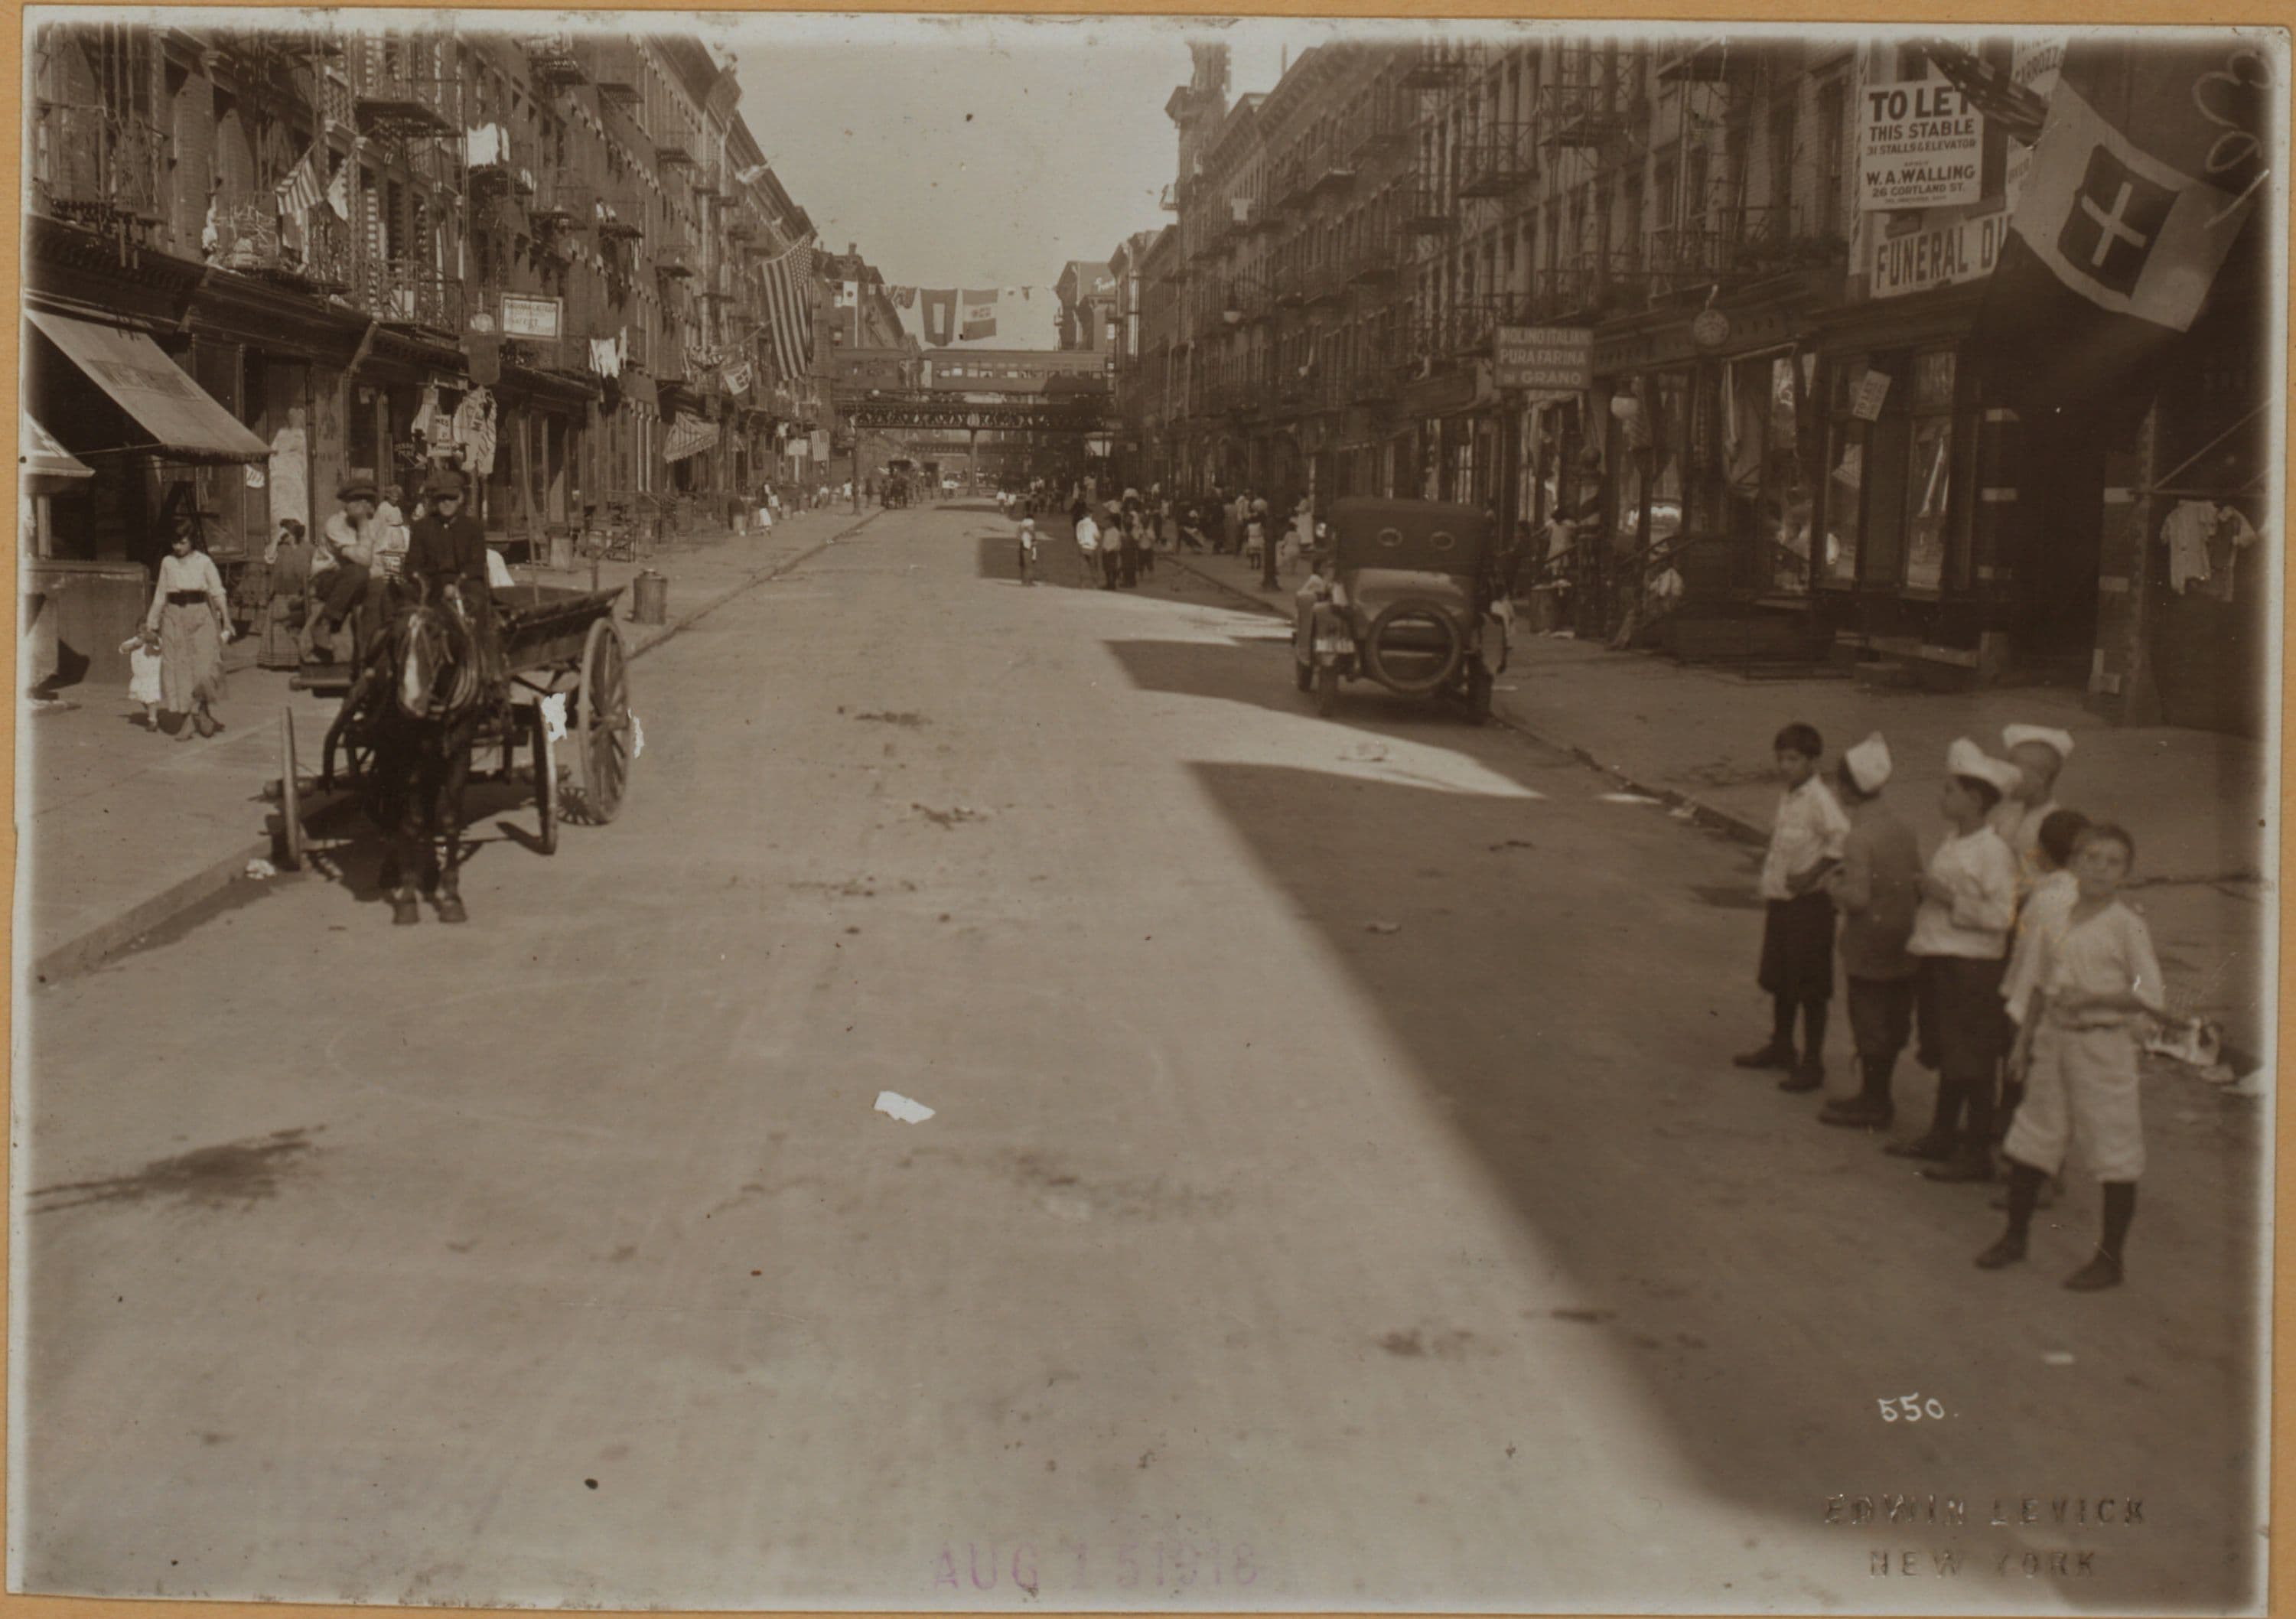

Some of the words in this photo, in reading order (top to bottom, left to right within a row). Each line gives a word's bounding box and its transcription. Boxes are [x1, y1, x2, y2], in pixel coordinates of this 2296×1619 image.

[1869, 90, 1907, 122] TO
[1915, 86, 1969, 118] LET
[1869, 125, 1903, 142] THIS
[1909, 119, 1975, 138] STABLE
[1872, 187, 1887, 197] 26
[1891, 184, 1946, 196] CORTLAND
[1877, 226, 1969, 289] FUNERAL
[1500, 348, 1535, 365] PURA
[1536, 349, 1586, 366] FARINA
[1520, 370, 1581, 386] GRANO
